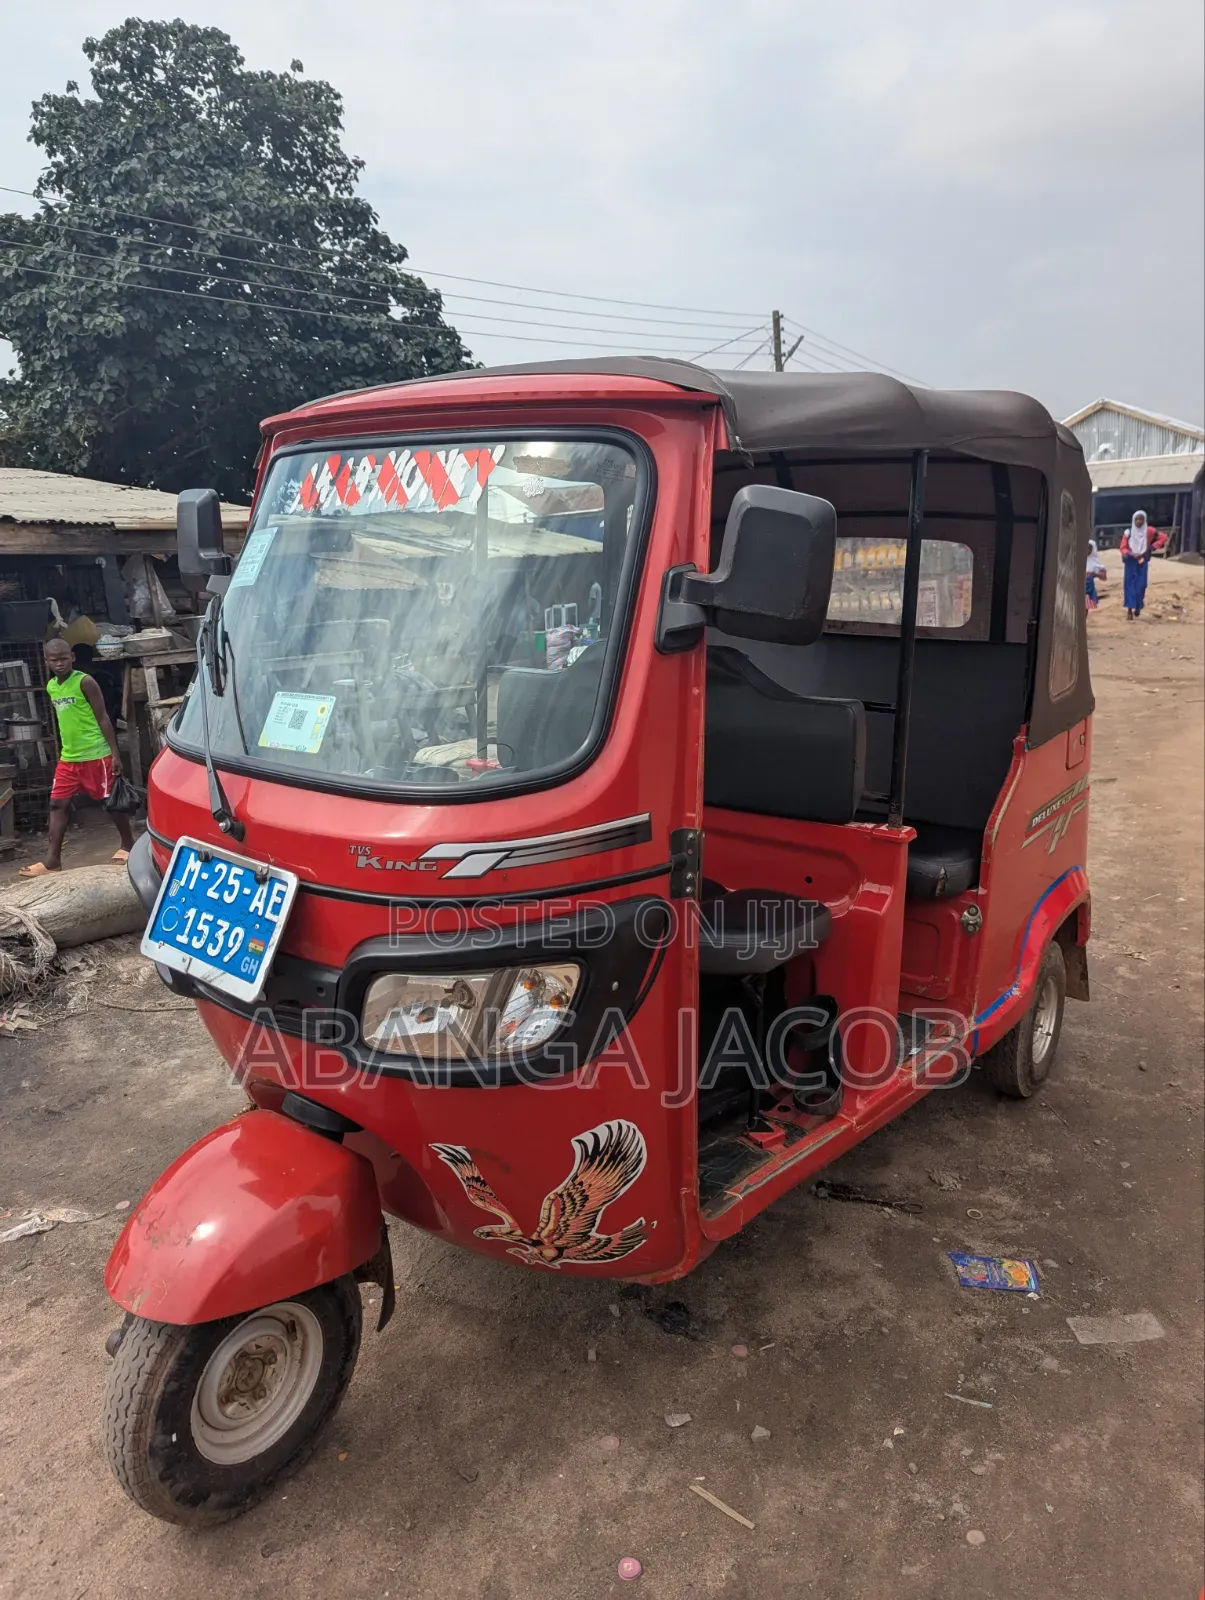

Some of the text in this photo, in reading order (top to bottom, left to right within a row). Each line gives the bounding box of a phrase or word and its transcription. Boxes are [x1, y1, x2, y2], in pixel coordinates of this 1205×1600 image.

[367, 445, 505, 512] MONEY
[349, 845, 372, 855] TVS
[180, 852, 288, 924] M-25-AE
[175, 907, 245, 963] 1539
[240, 956, 260, 977] GH
